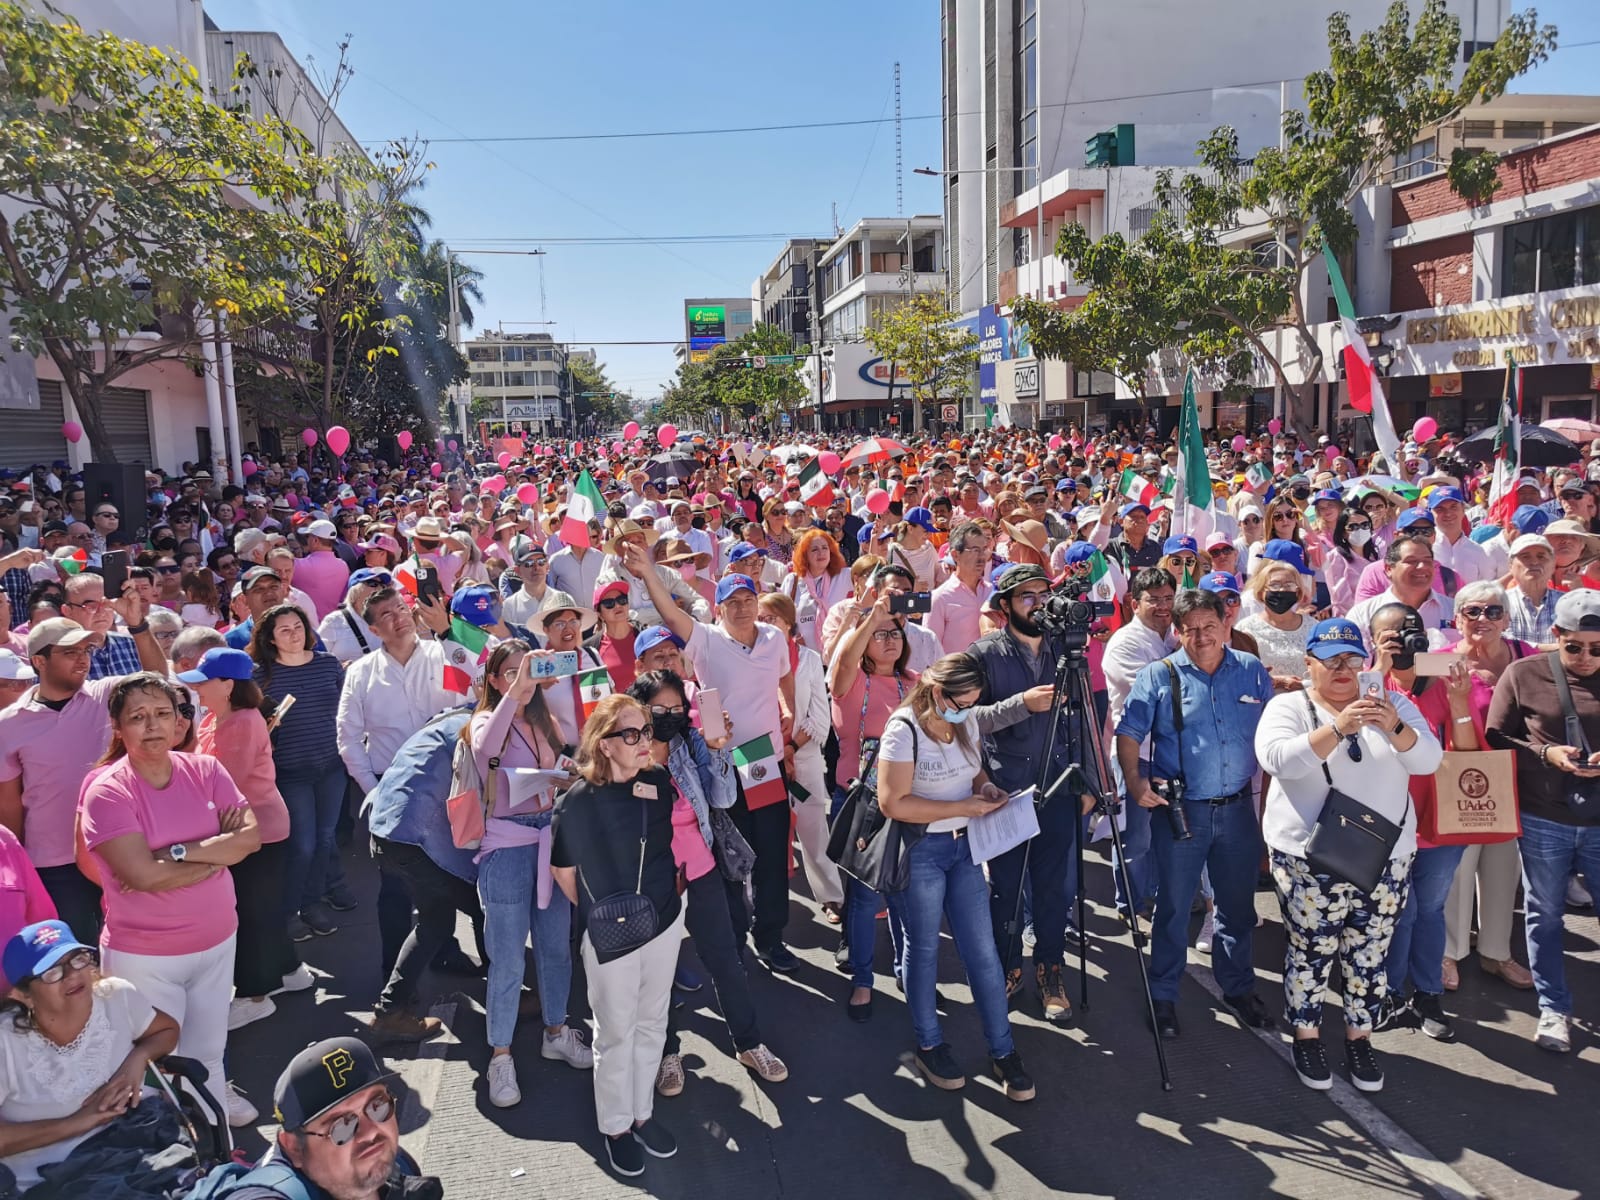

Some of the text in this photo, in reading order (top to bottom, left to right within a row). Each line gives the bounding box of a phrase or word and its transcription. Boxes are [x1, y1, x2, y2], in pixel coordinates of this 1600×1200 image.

[985, 324, 996, 338] LAS
[1407, 303, 1535, 345] RESTAURANTE
[980, 337, 1003, 352] MEJORES
[980, 351, 1002, 365] MARCAS
[1453, 349, 1496, 367] COMIDA
[1546, 341, 1557, 360] Y
[1015, 368, 1036, 391] OXXO
[1319, 633, 1360, 641] SAUCEDA
[1457, 799, 1497, 811] UAdeO
[322, 1048, 355, 1089] P
